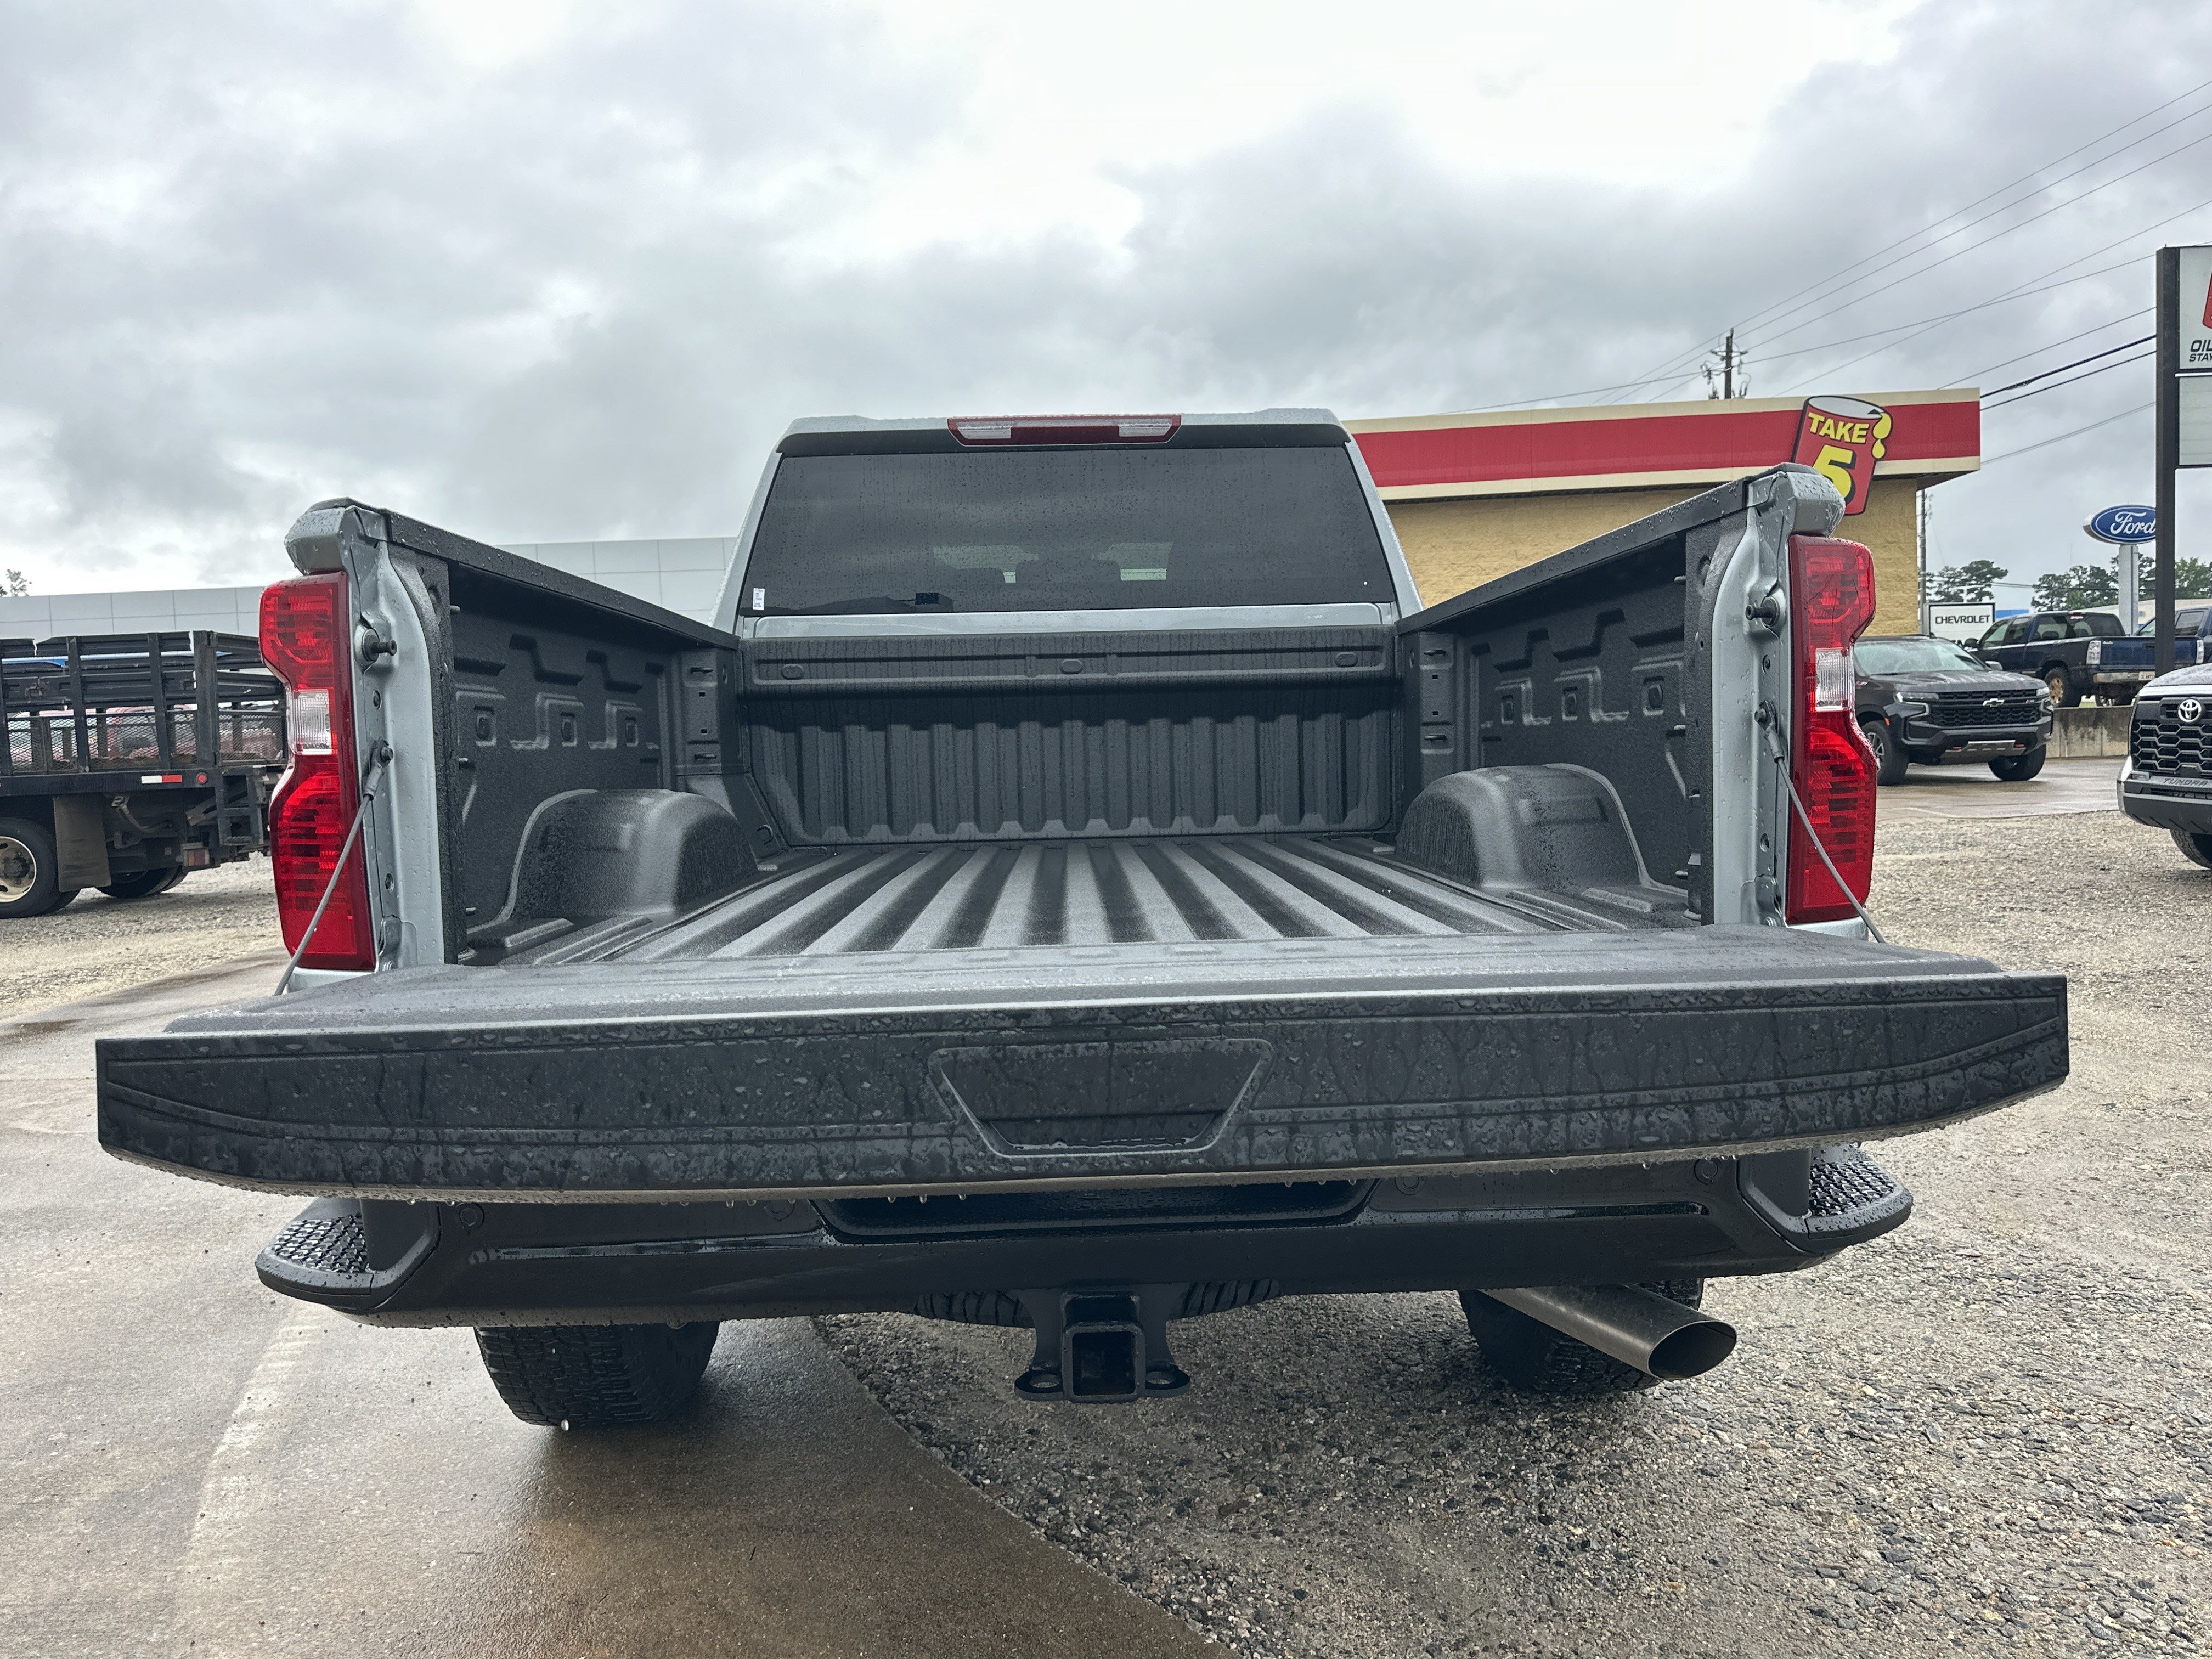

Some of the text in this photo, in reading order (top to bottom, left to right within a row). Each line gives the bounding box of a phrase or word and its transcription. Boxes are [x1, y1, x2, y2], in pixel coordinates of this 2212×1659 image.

[2190, 339, 2212, 352] OIL
[1808, 412, 1870, 444] TAKE
[1813, 444, 1855, 502] 5
[2110, 511, 2156, 535] Ford
[1935, 615, 1990, 624] CHEVROLET
[2163, 777, 2208, 786] TUNDRA
